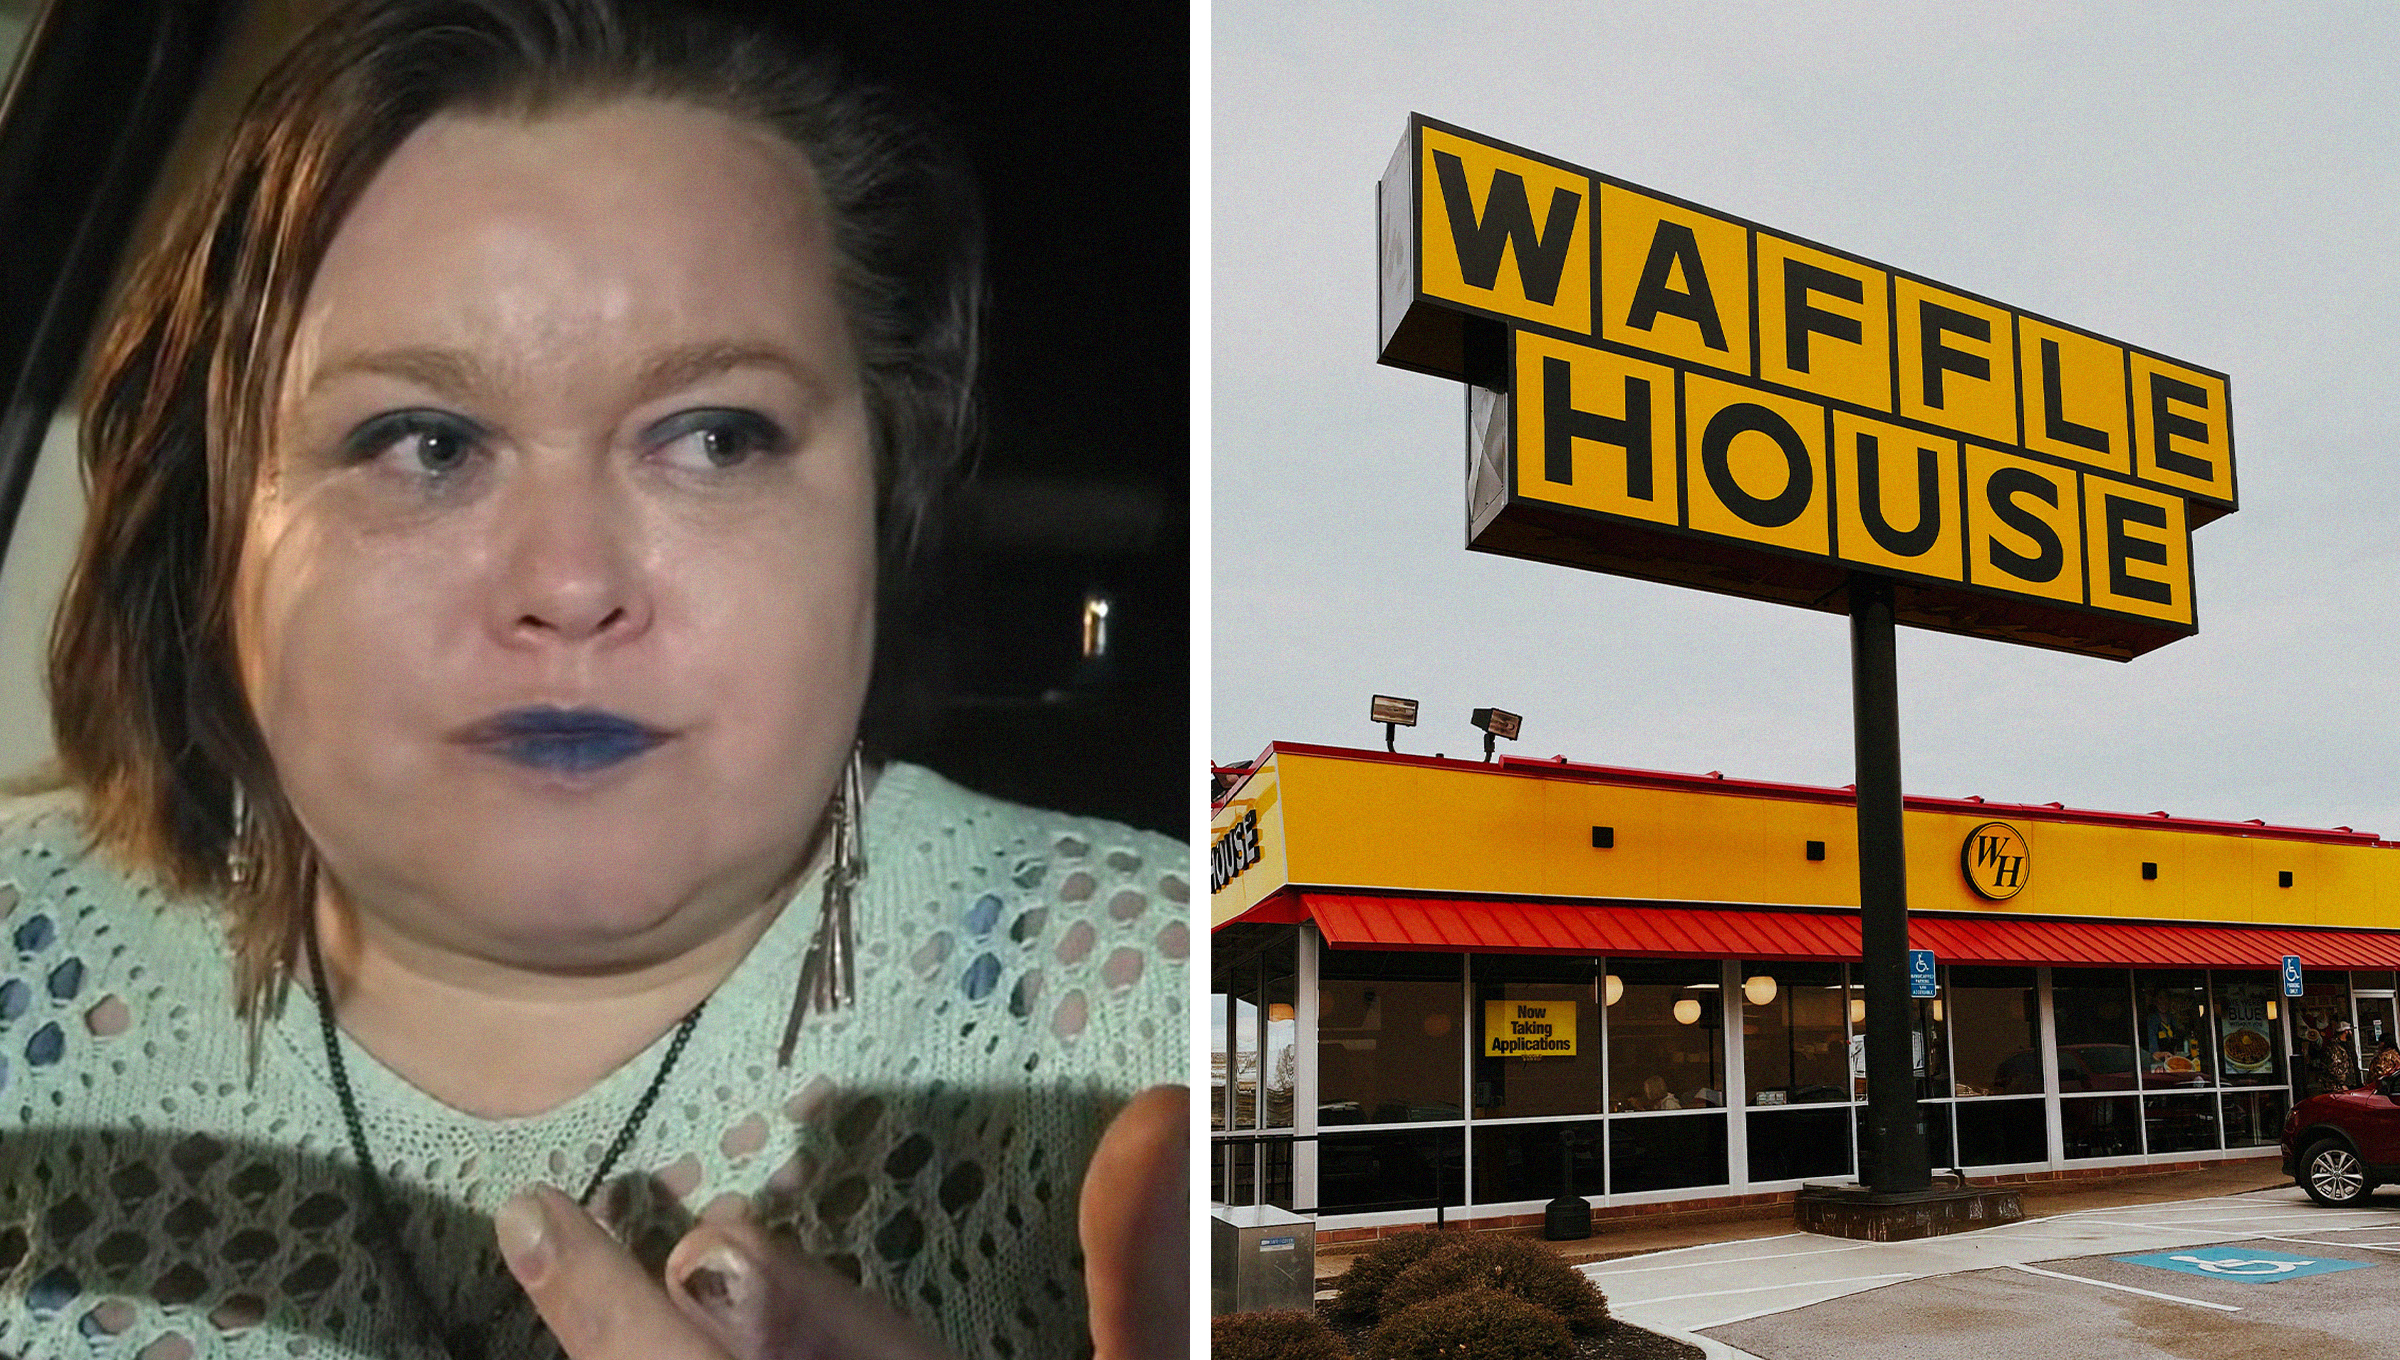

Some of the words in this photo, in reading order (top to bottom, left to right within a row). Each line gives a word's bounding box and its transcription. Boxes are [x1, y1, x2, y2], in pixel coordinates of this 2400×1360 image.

[1431, 149, 2214, 482] WAFFLE
[1543, 358, 2173, 605] HOUSE
[1517, 1005, 1547, 1019] Now
[2228, 1007, 2262, 1020] BLUE
[1510, 1021, 1552, 1037] Taking
[1492, 1037, 1571, 1054] Applications
